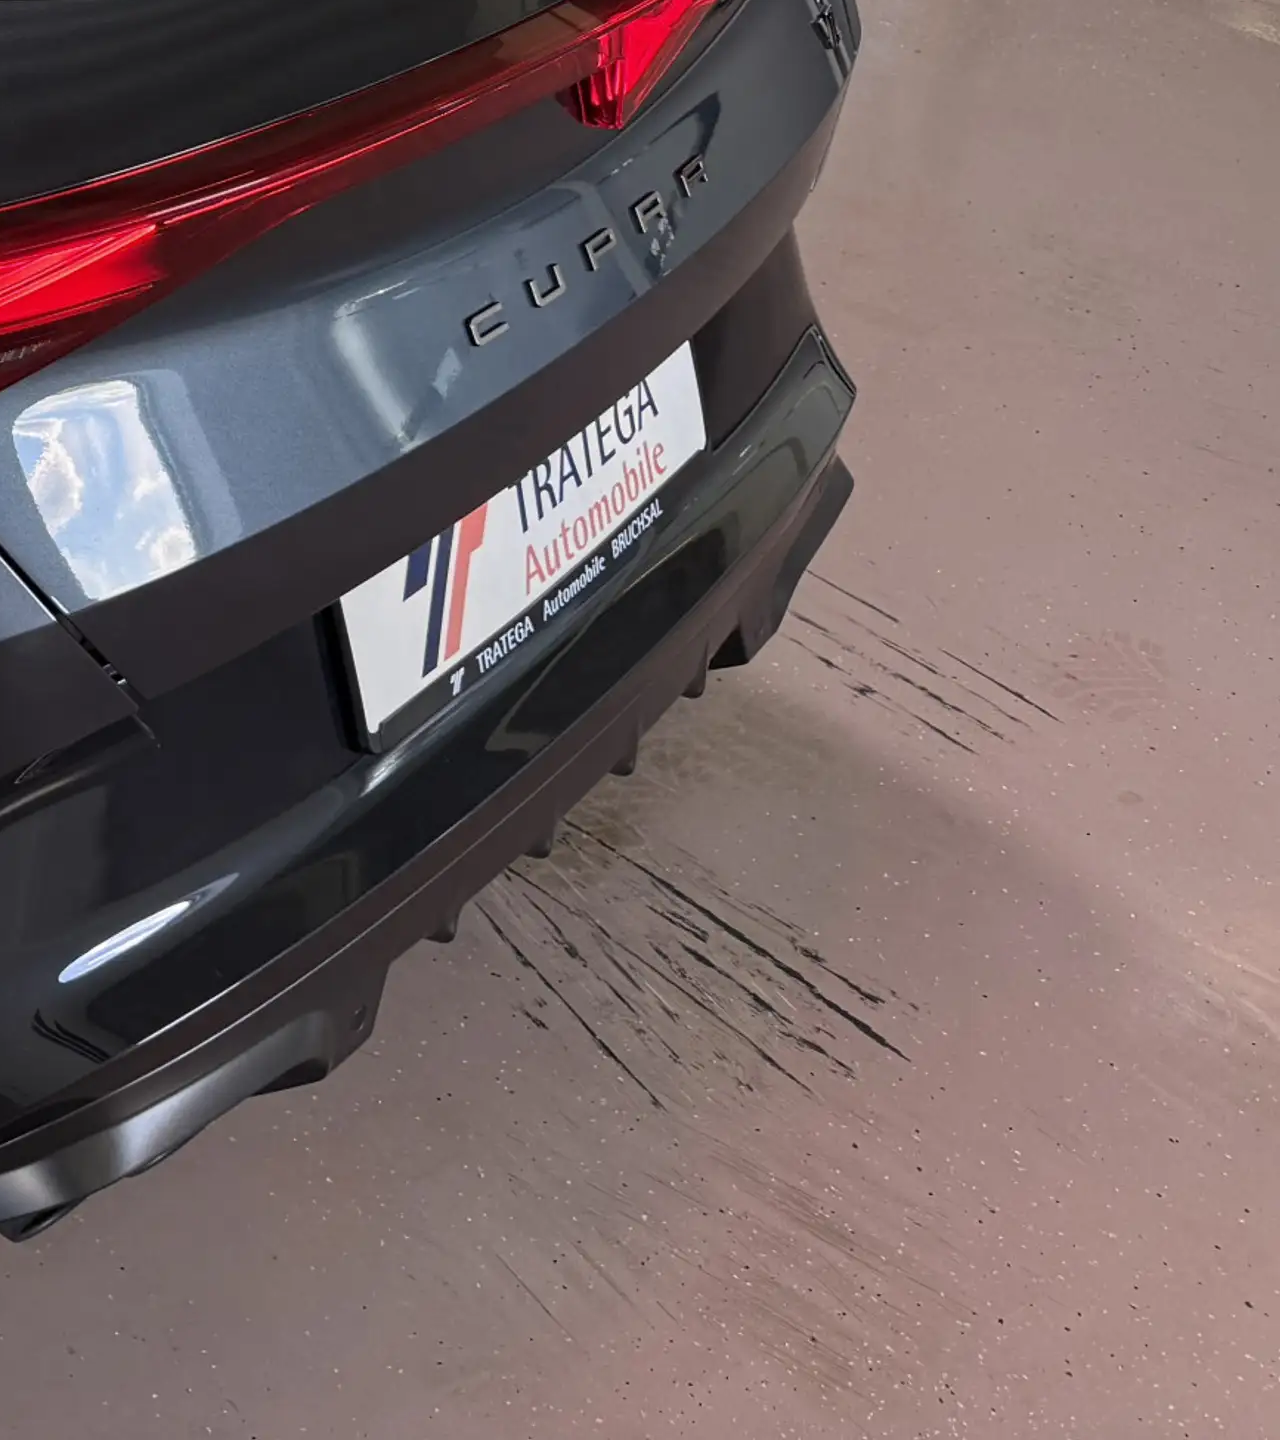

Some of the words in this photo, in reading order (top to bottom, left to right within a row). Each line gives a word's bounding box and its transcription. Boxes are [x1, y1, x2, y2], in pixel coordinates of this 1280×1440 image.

[464, 154, 709, 347] CUPRA
[508, 378, 659, 534] TRATEGA
[524, 440, 667, 596] Automobile
[476, 616, 534, 673] TRATEGA
[543, 556, 606, 621] Automobile
[611, 498, 663, 559] BRUCHSAL
